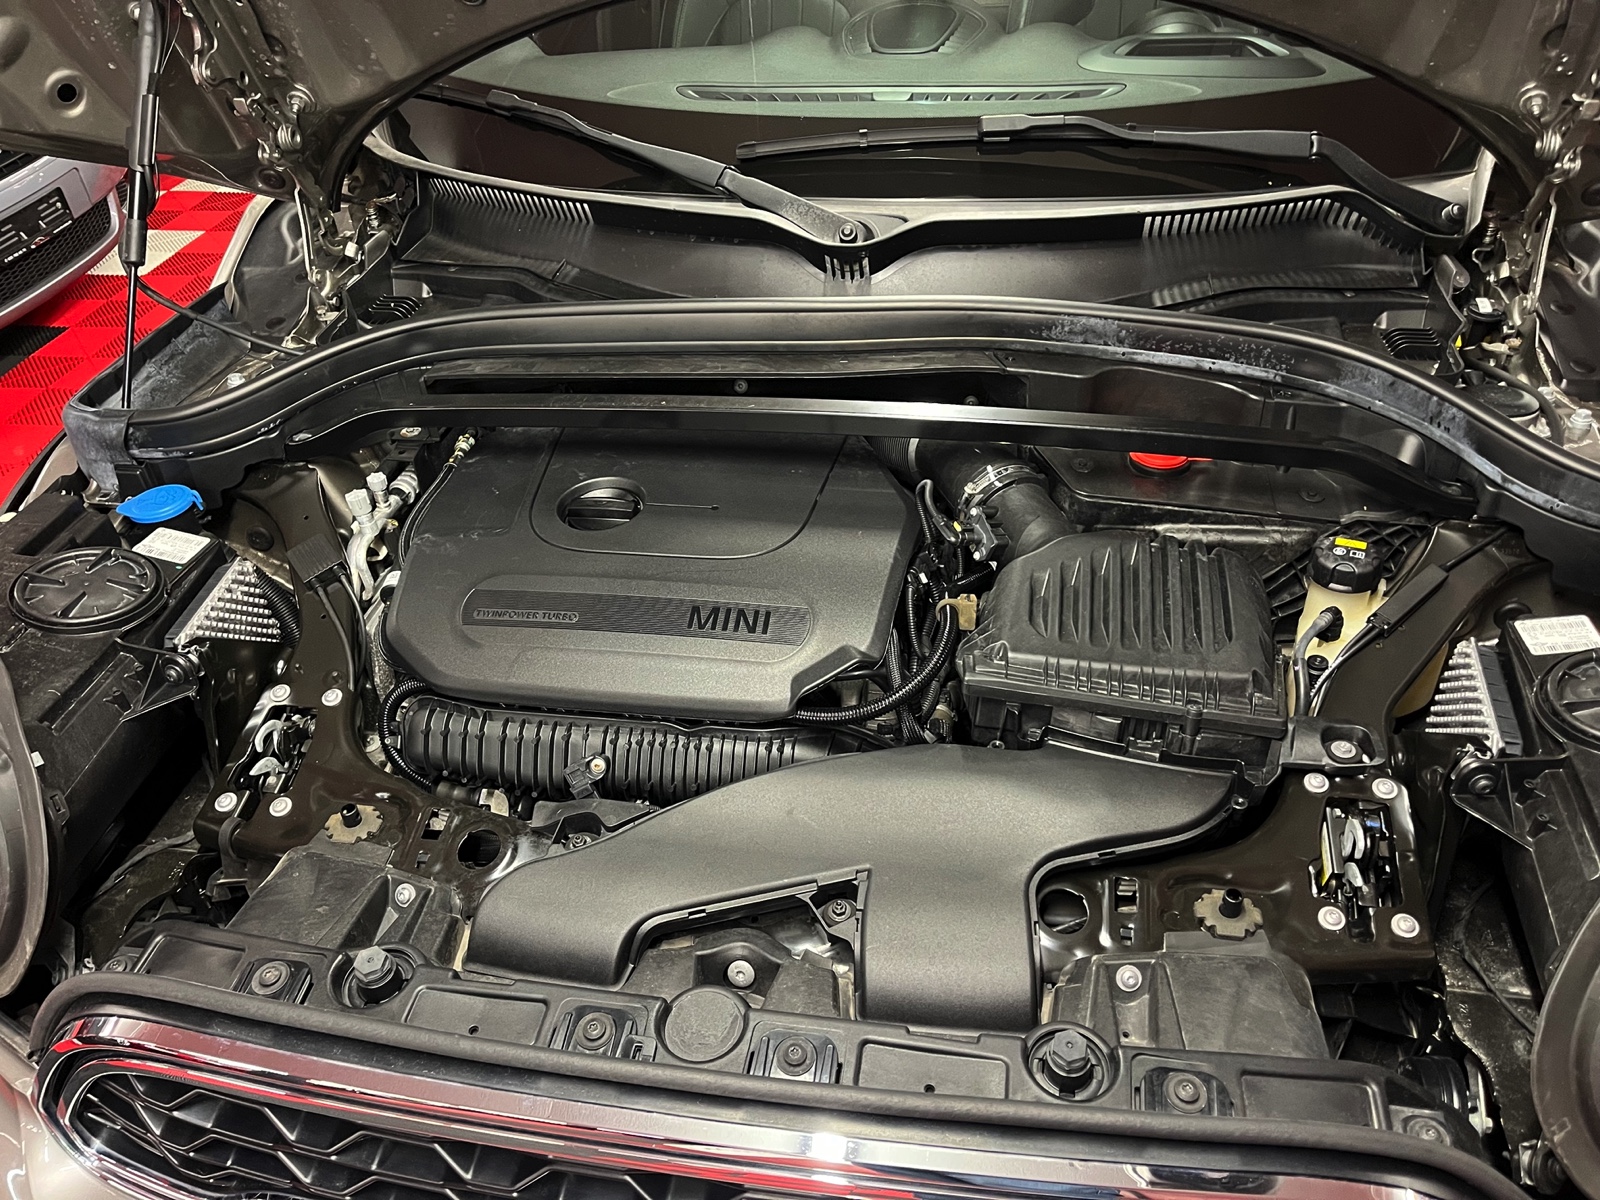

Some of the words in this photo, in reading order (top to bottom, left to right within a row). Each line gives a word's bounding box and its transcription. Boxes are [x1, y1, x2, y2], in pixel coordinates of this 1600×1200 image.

[476, 609, 540, 620] TWINPOWER
[541, 611, 578, 622] TURBO
[687, 605, 772, 635] MINI
